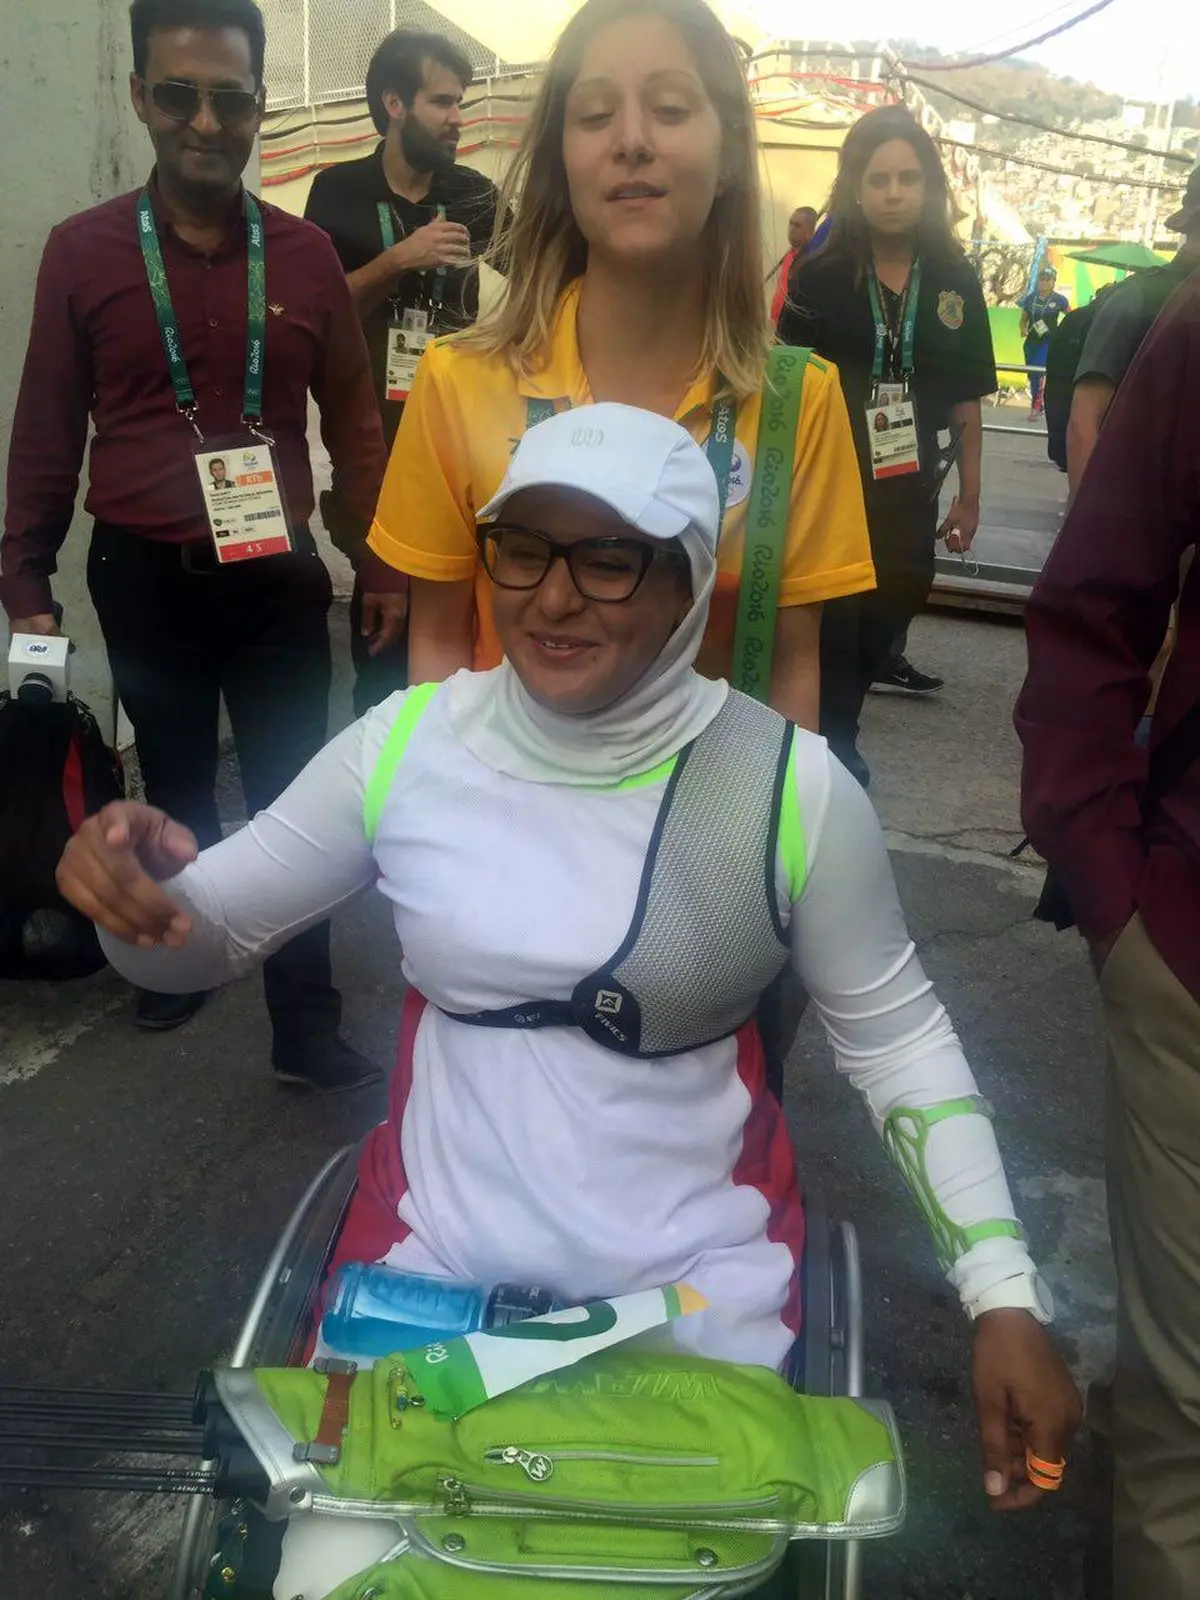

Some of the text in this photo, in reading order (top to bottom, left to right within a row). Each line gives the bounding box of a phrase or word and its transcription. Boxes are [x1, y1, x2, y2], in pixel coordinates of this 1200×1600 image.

[140, 210, 152, 233] Atos
[251, 223, 260, 247] Atos
[164, 326, 181, 363] Rio2016
[250, 339, 260, 375] Rio2016
[715, 405, 729, 443] Atos
[757, 447, 784, 528] Rio2016
[748, 544, 773, 622] Rio2016
[742, 637, 764, 693] Rio20
